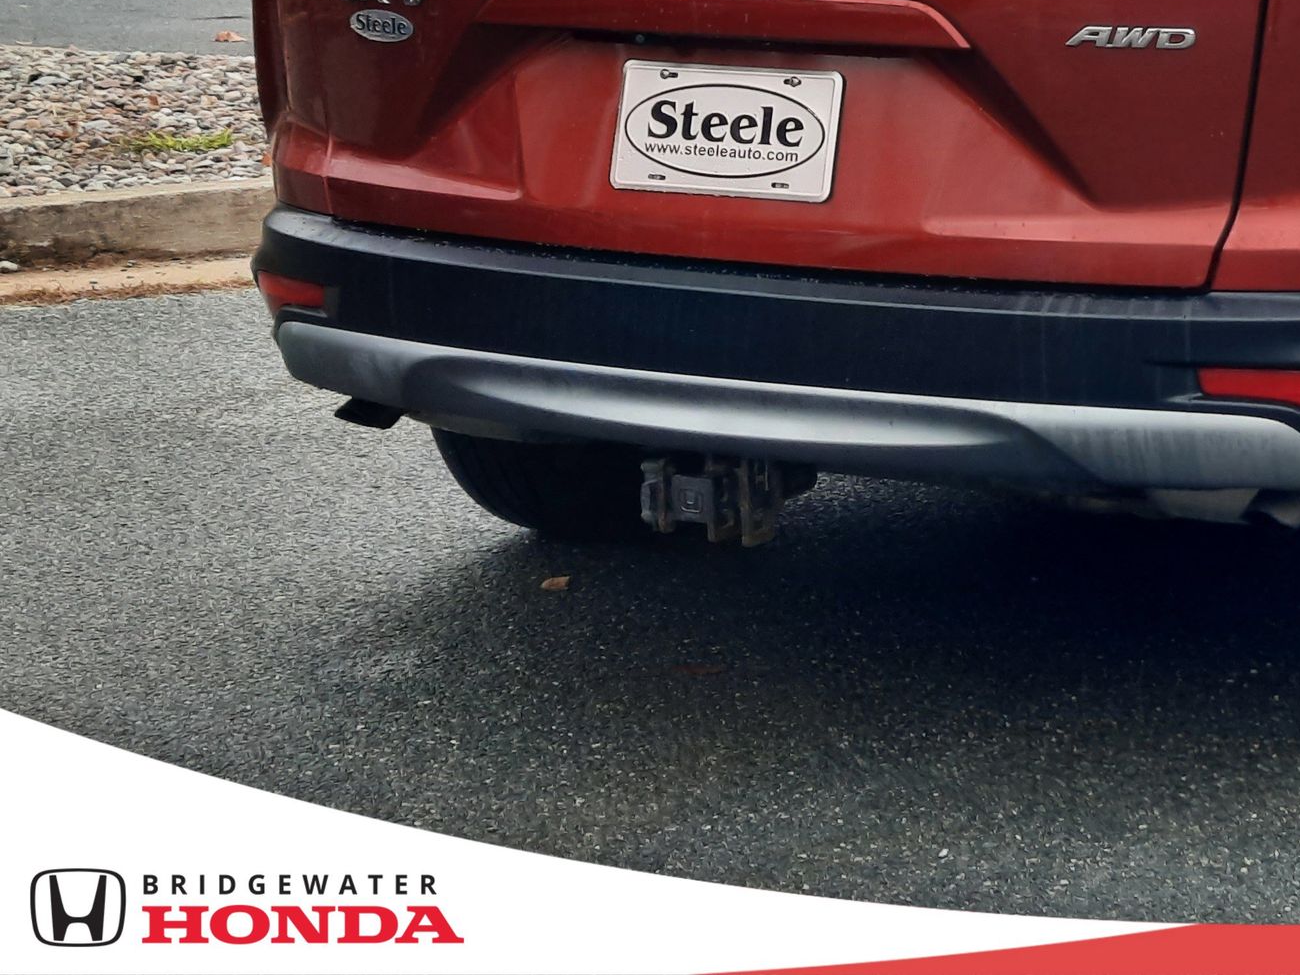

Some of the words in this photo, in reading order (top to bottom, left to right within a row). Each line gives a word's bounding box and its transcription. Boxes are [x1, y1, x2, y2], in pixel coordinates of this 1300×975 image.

[355, 13, 408, 36] Steele
[1065, 25, 1197, 49] AWD
[647, 99, 804, 147] Steele
[645, 142, 799, 163] www.steeleauto.com
